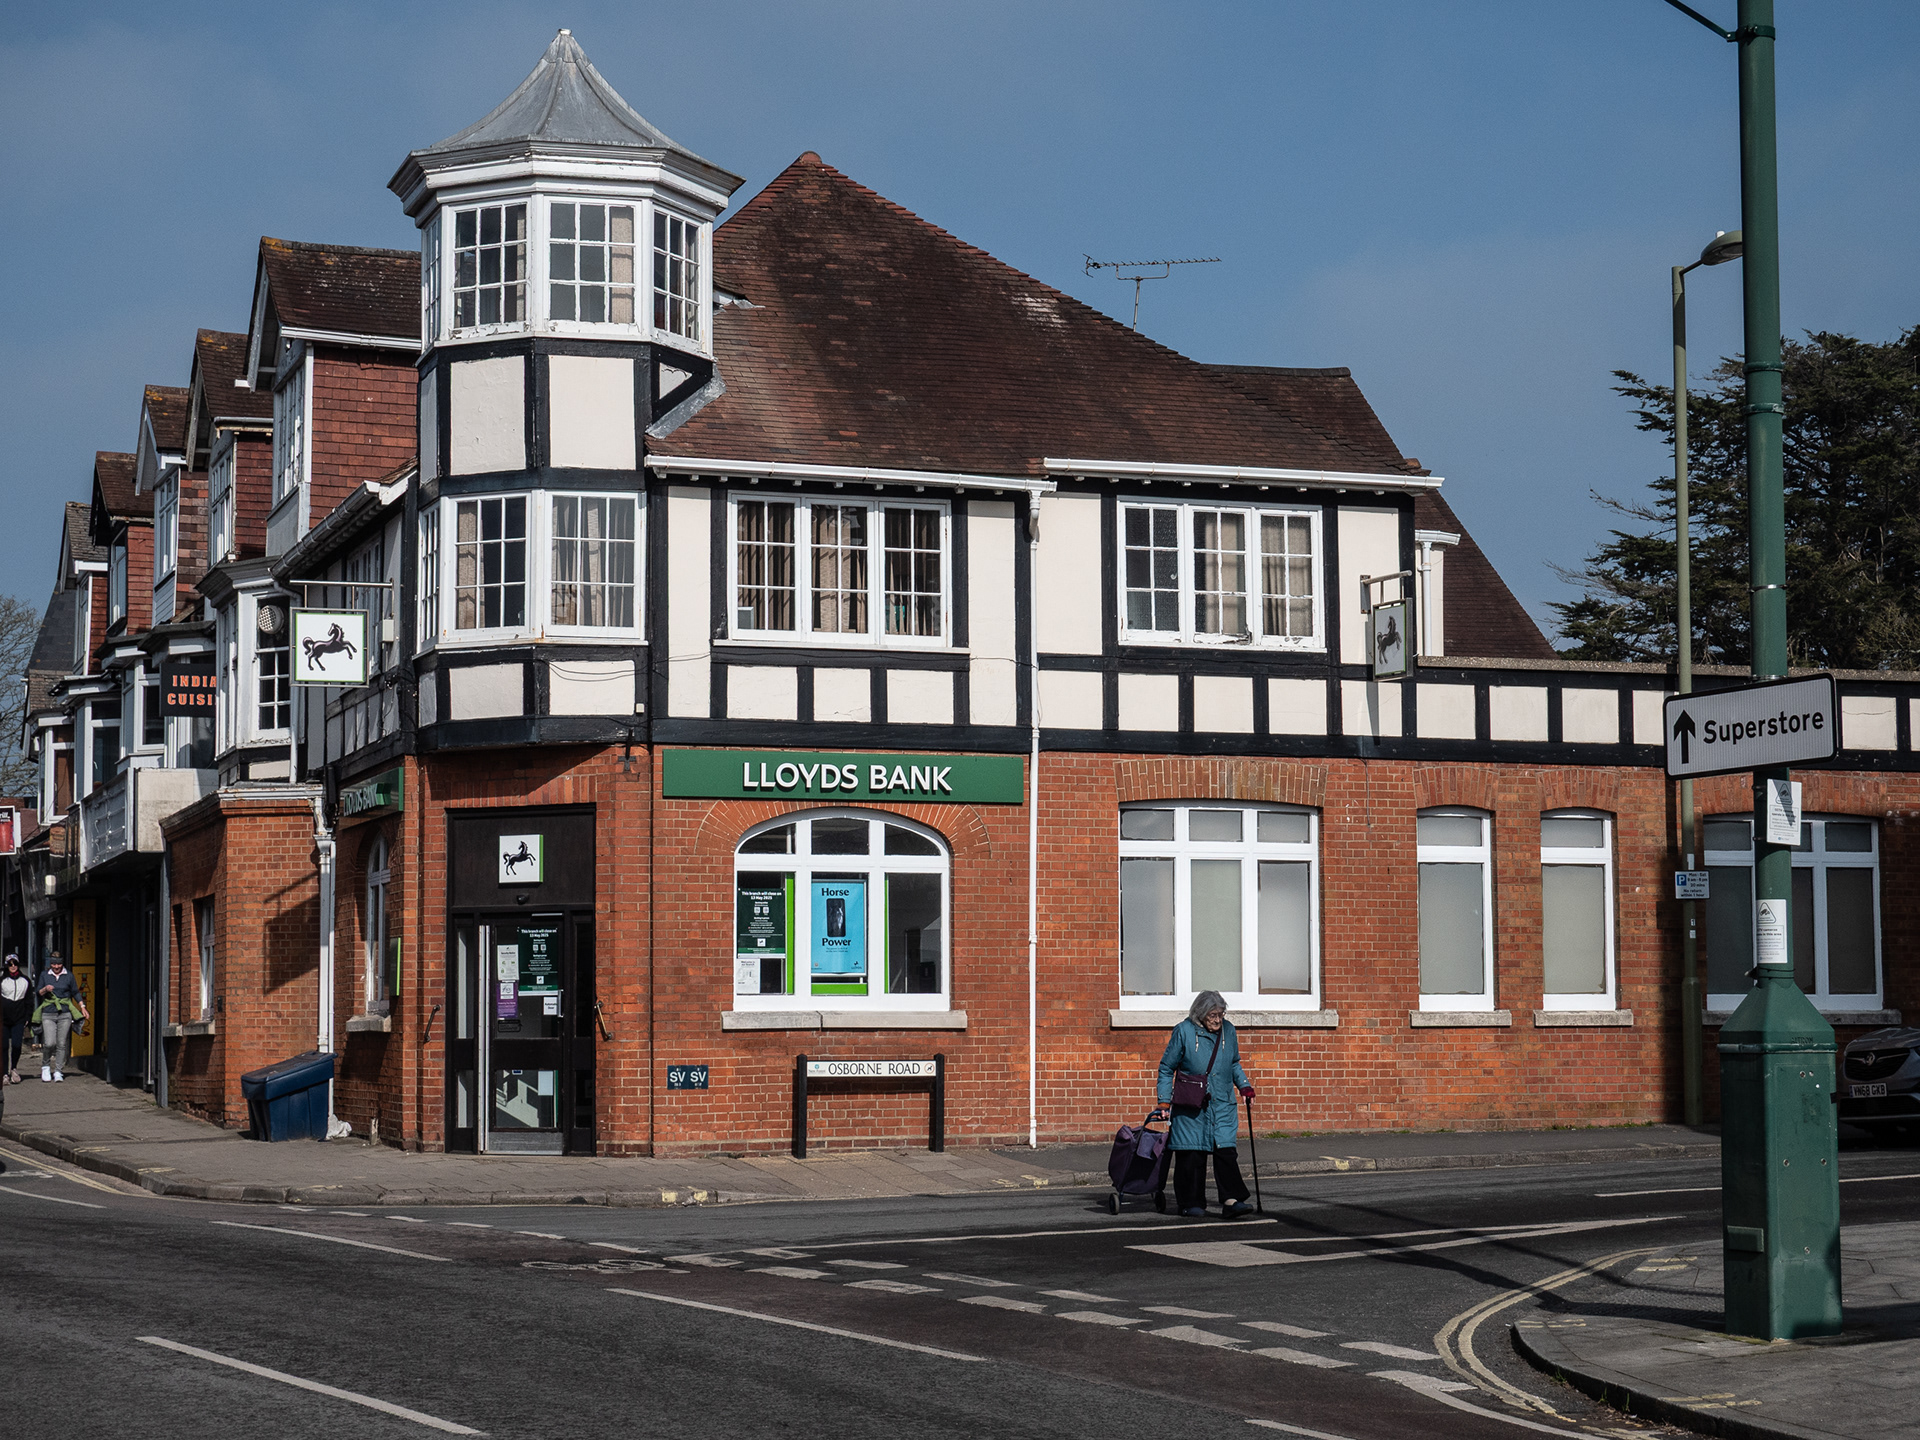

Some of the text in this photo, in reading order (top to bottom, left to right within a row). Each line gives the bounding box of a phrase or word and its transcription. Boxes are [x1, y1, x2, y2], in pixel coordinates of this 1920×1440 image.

[167, 692, 216, 706] CUISI
[1703, 710, 1825, 744] Superstore
[742, 762, 952, 792] LLOYDS BANK
[1678, 876, 1685, 885] P
[822, 888, 850, 896] Horse
[822, 938, 852, 946] Power
[828, 1063, 920, 1075] OSBORNE ROAD
[669, 1071, 686, 1083] SV
[690, 1071, 707, 1083] SV
